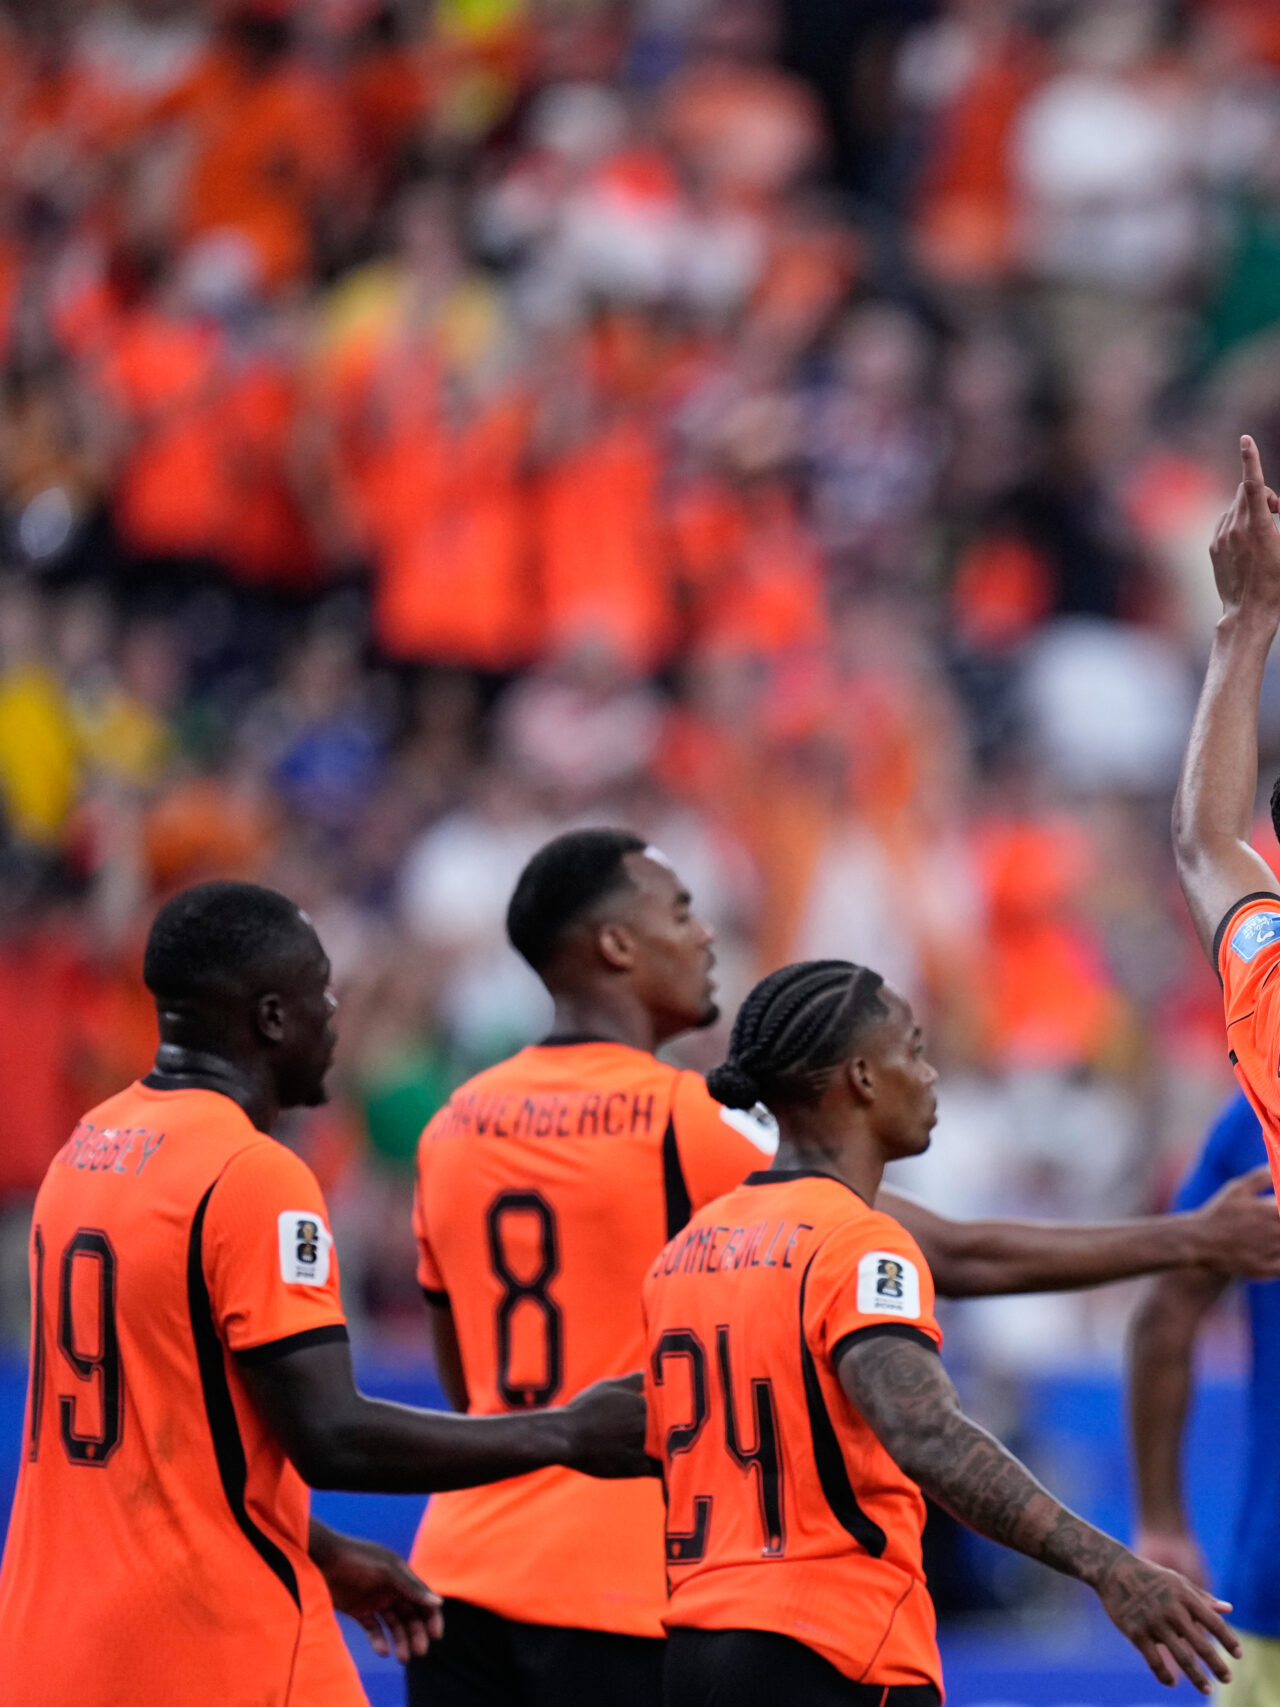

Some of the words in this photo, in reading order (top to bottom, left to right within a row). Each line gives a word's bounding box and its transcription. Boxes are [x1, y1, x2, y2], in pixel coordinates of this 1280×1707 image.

[432, 1094, 655, 1138] AVENBERCH
[28, 1224, 126, 1469] 19
[486, 1188, 564, 1409] 8
[652, 1324, 786, 1564] 24
